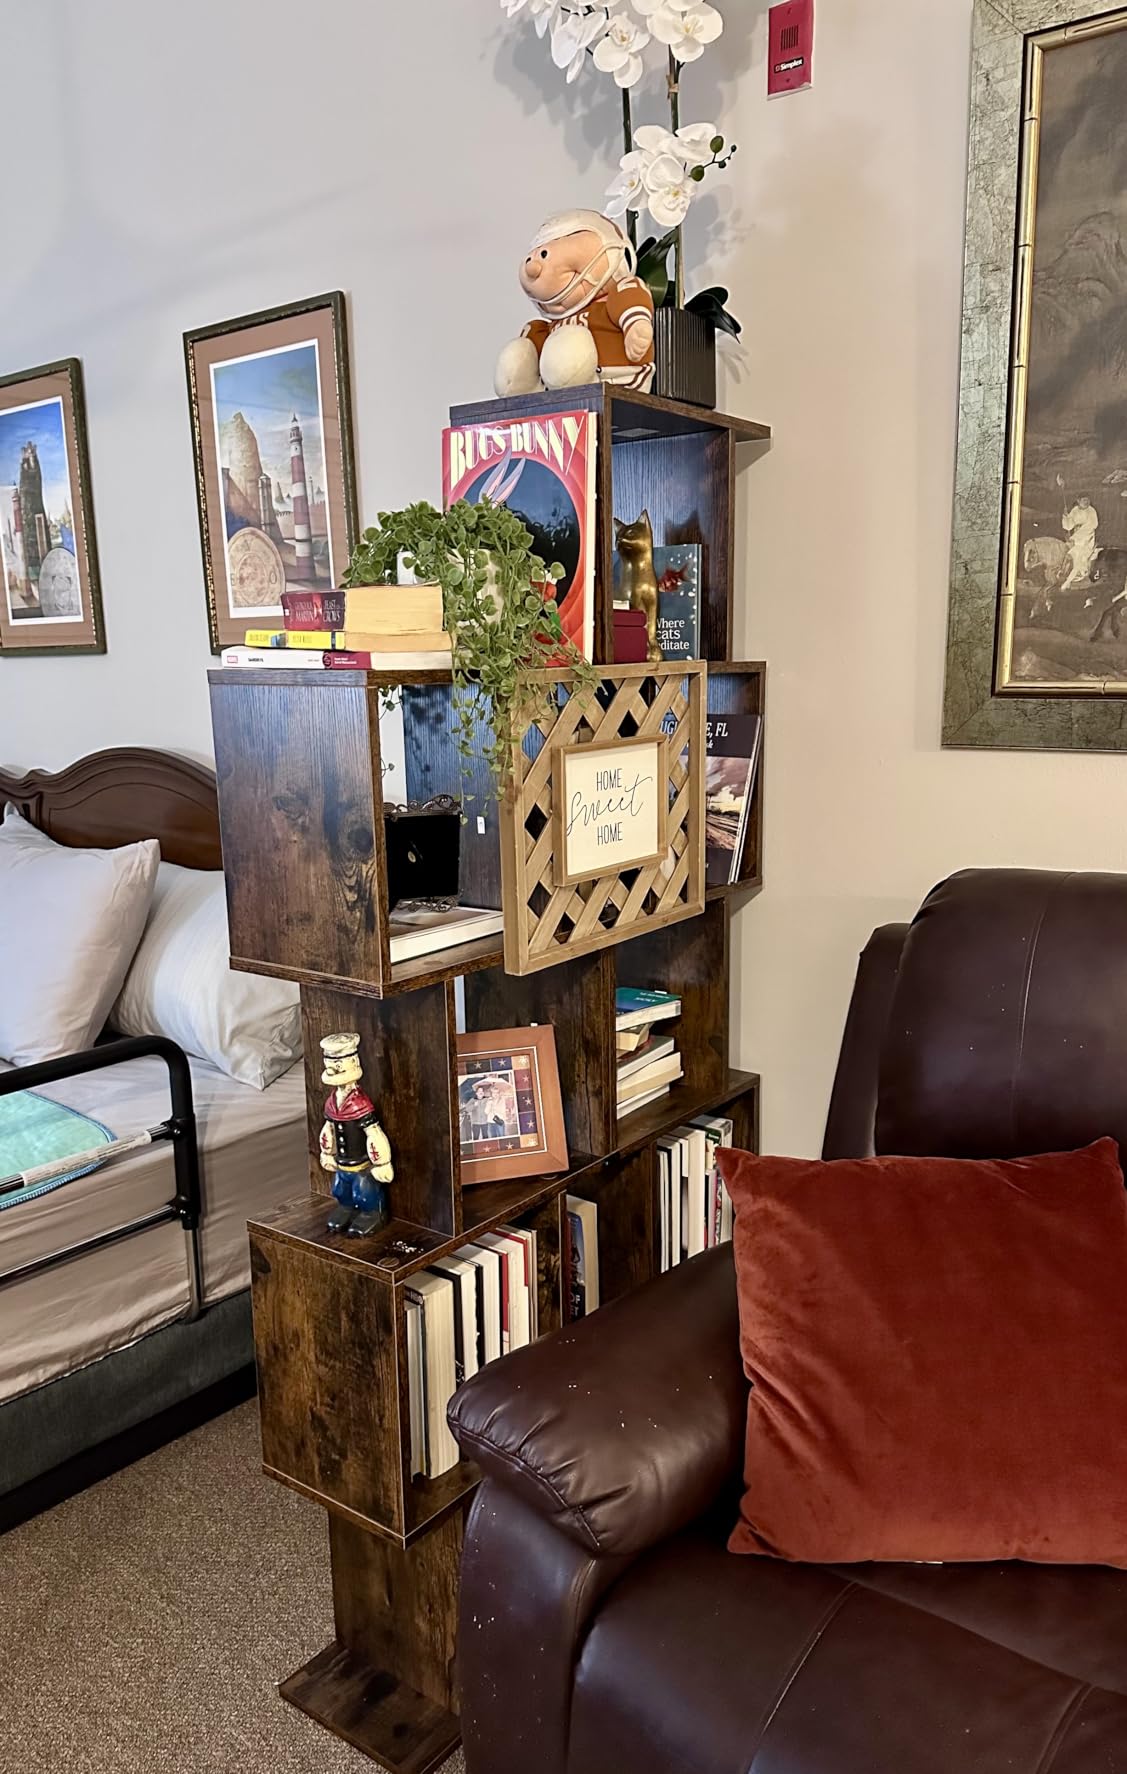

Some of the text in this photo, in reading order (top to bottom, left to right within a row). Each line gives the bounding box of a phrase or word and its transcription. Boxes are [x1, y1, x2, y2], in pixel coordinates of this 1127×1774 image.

[450, 416, 585, 492] BUGS BUNNY
[658, 640, 690, 651] ditate
[715, 722, 729, 737] FL
[596, 768, 623, 792] HOME
[597, 822, 624, 846] HOME
